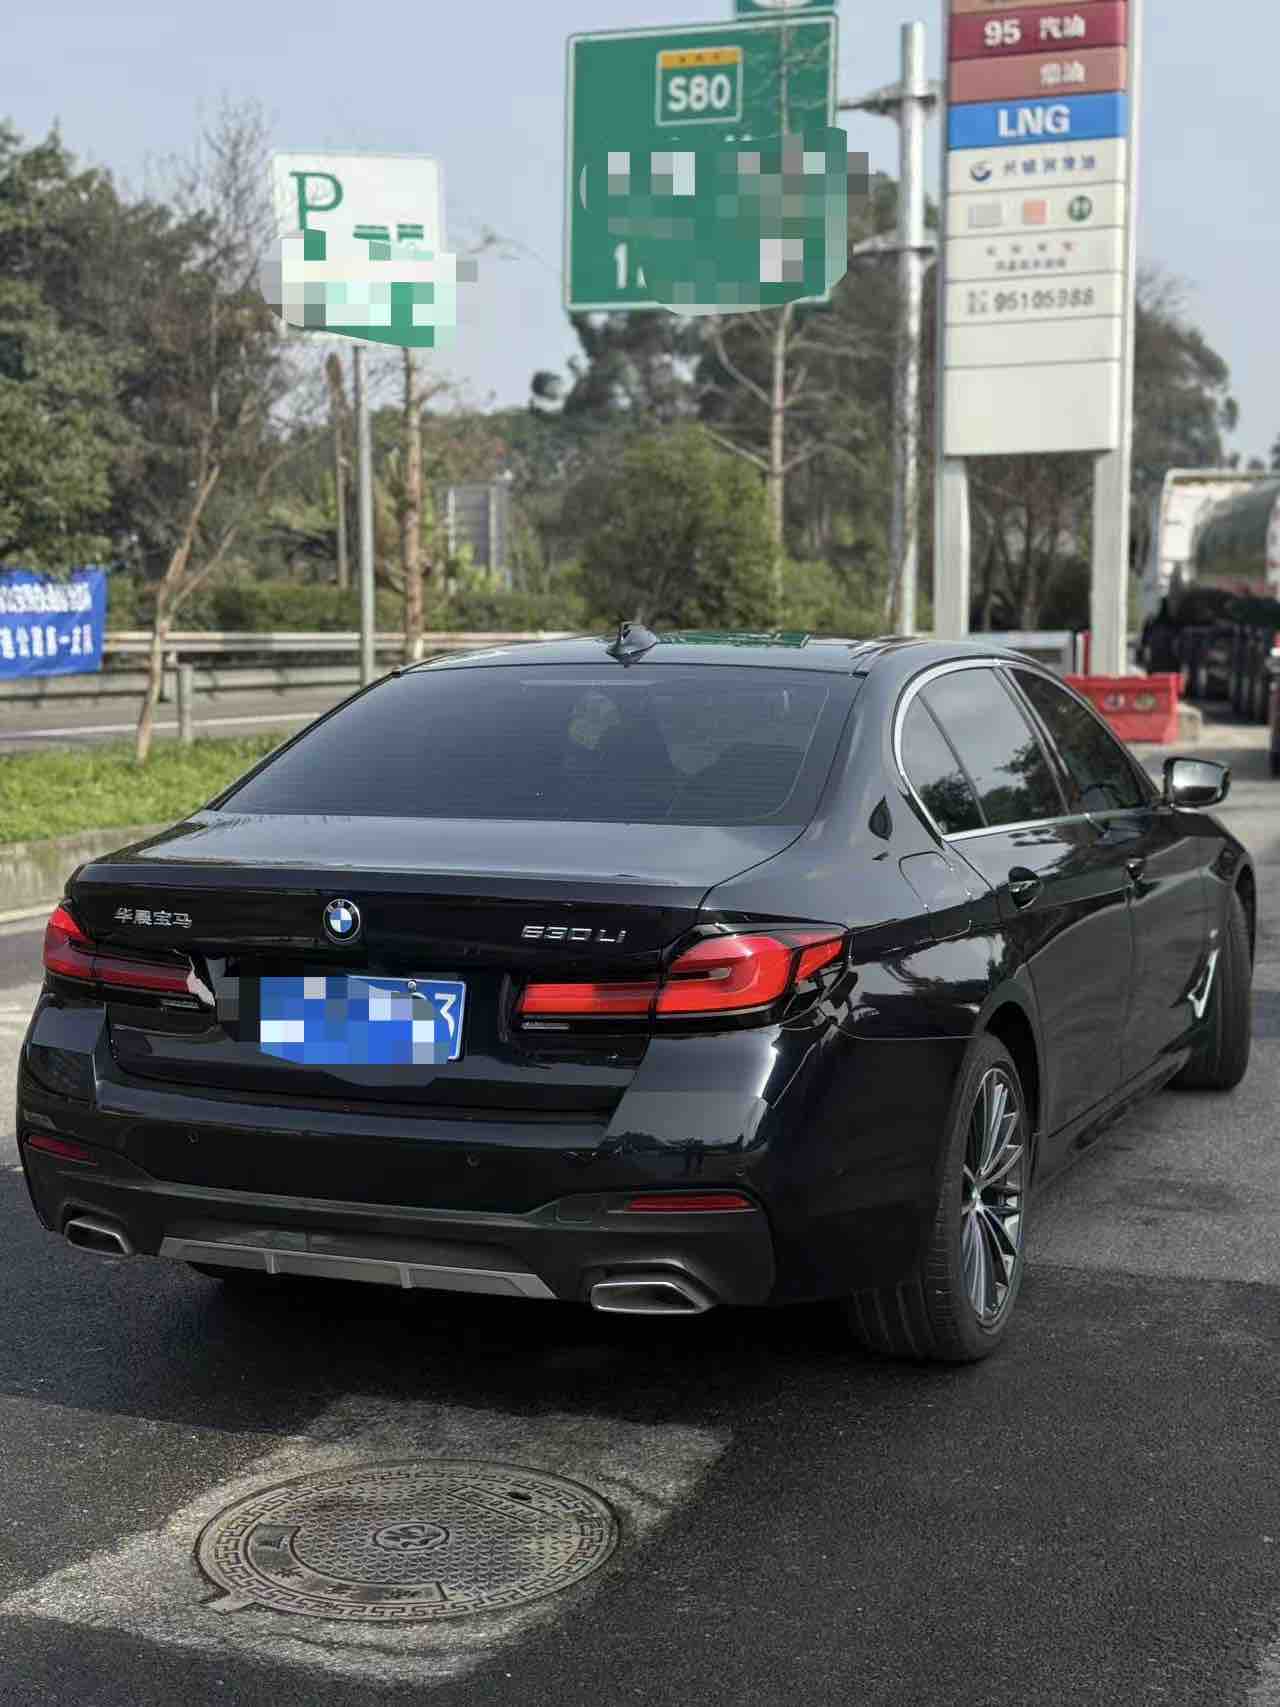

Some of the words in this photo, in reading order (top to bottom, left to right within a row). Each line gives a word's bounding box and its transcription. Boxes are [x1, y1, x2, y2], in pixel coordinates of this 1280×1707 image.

[983, 19, 1022, 47] 95
[667, 74, 731, 112] S80
[996, 105, 1071, 138] LNG
[289, 171, 344, 232] P
